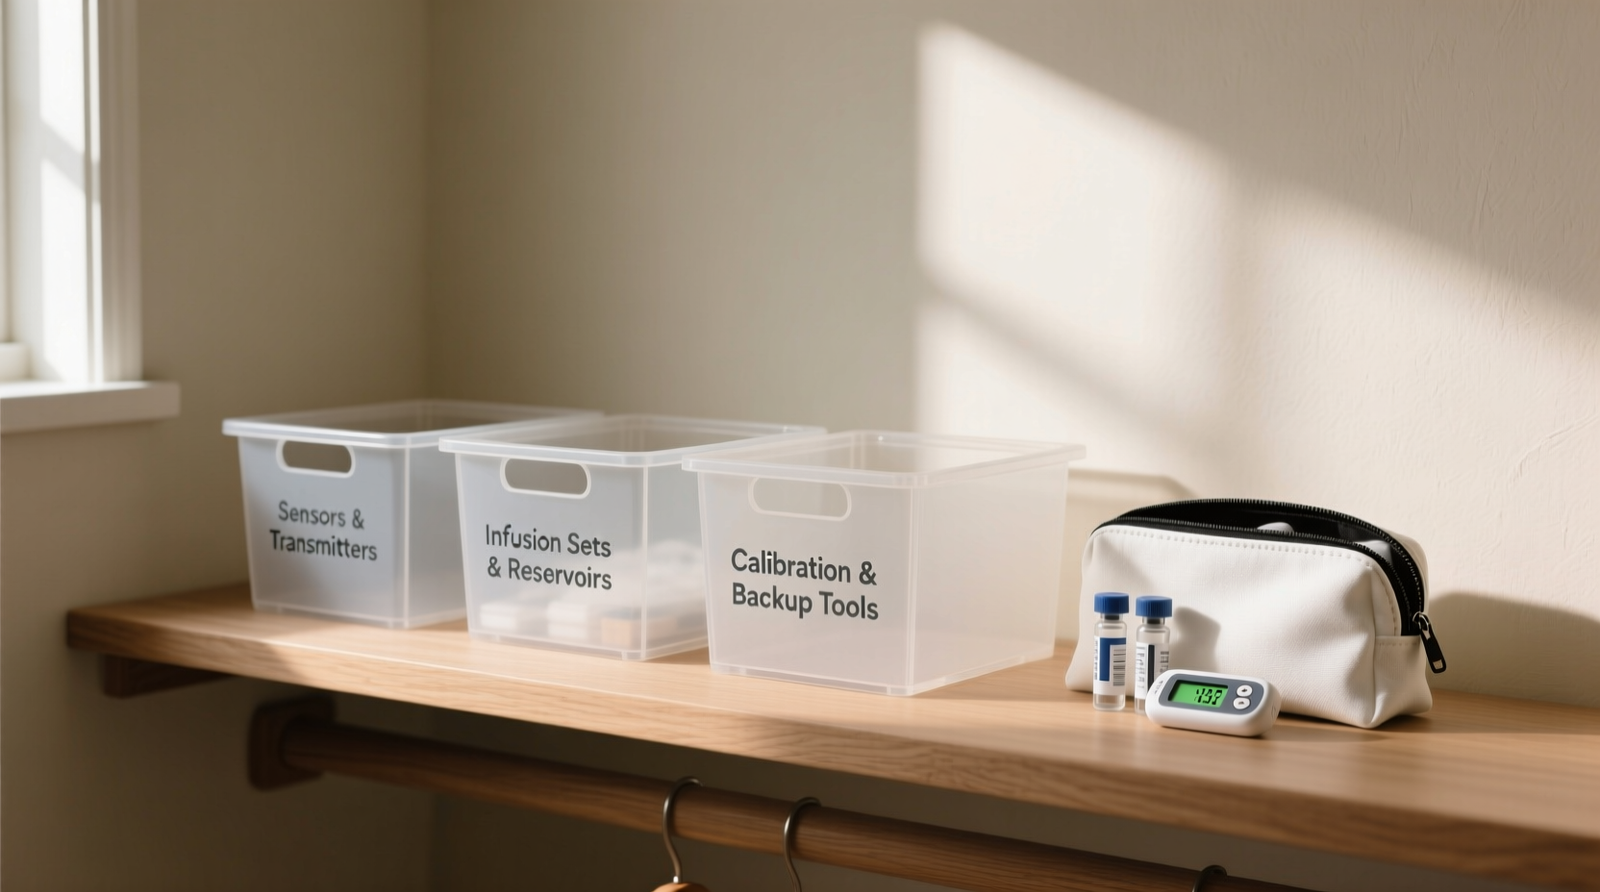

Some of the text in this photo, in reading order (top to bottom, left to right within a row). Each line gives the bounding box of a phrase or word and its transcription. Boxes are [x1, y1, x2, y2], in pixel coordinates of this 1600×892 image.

[278, 500, 364, 529] Sensors &
[269, 529, 378, 561] Transmitters
[485, 523, 612, 558] Infusion Sets
[487, 556, 612, 590] & Reservoirs
[731, 548, 877, 586] Calibration &
[732, 582, 879, 620] Backup Tools
